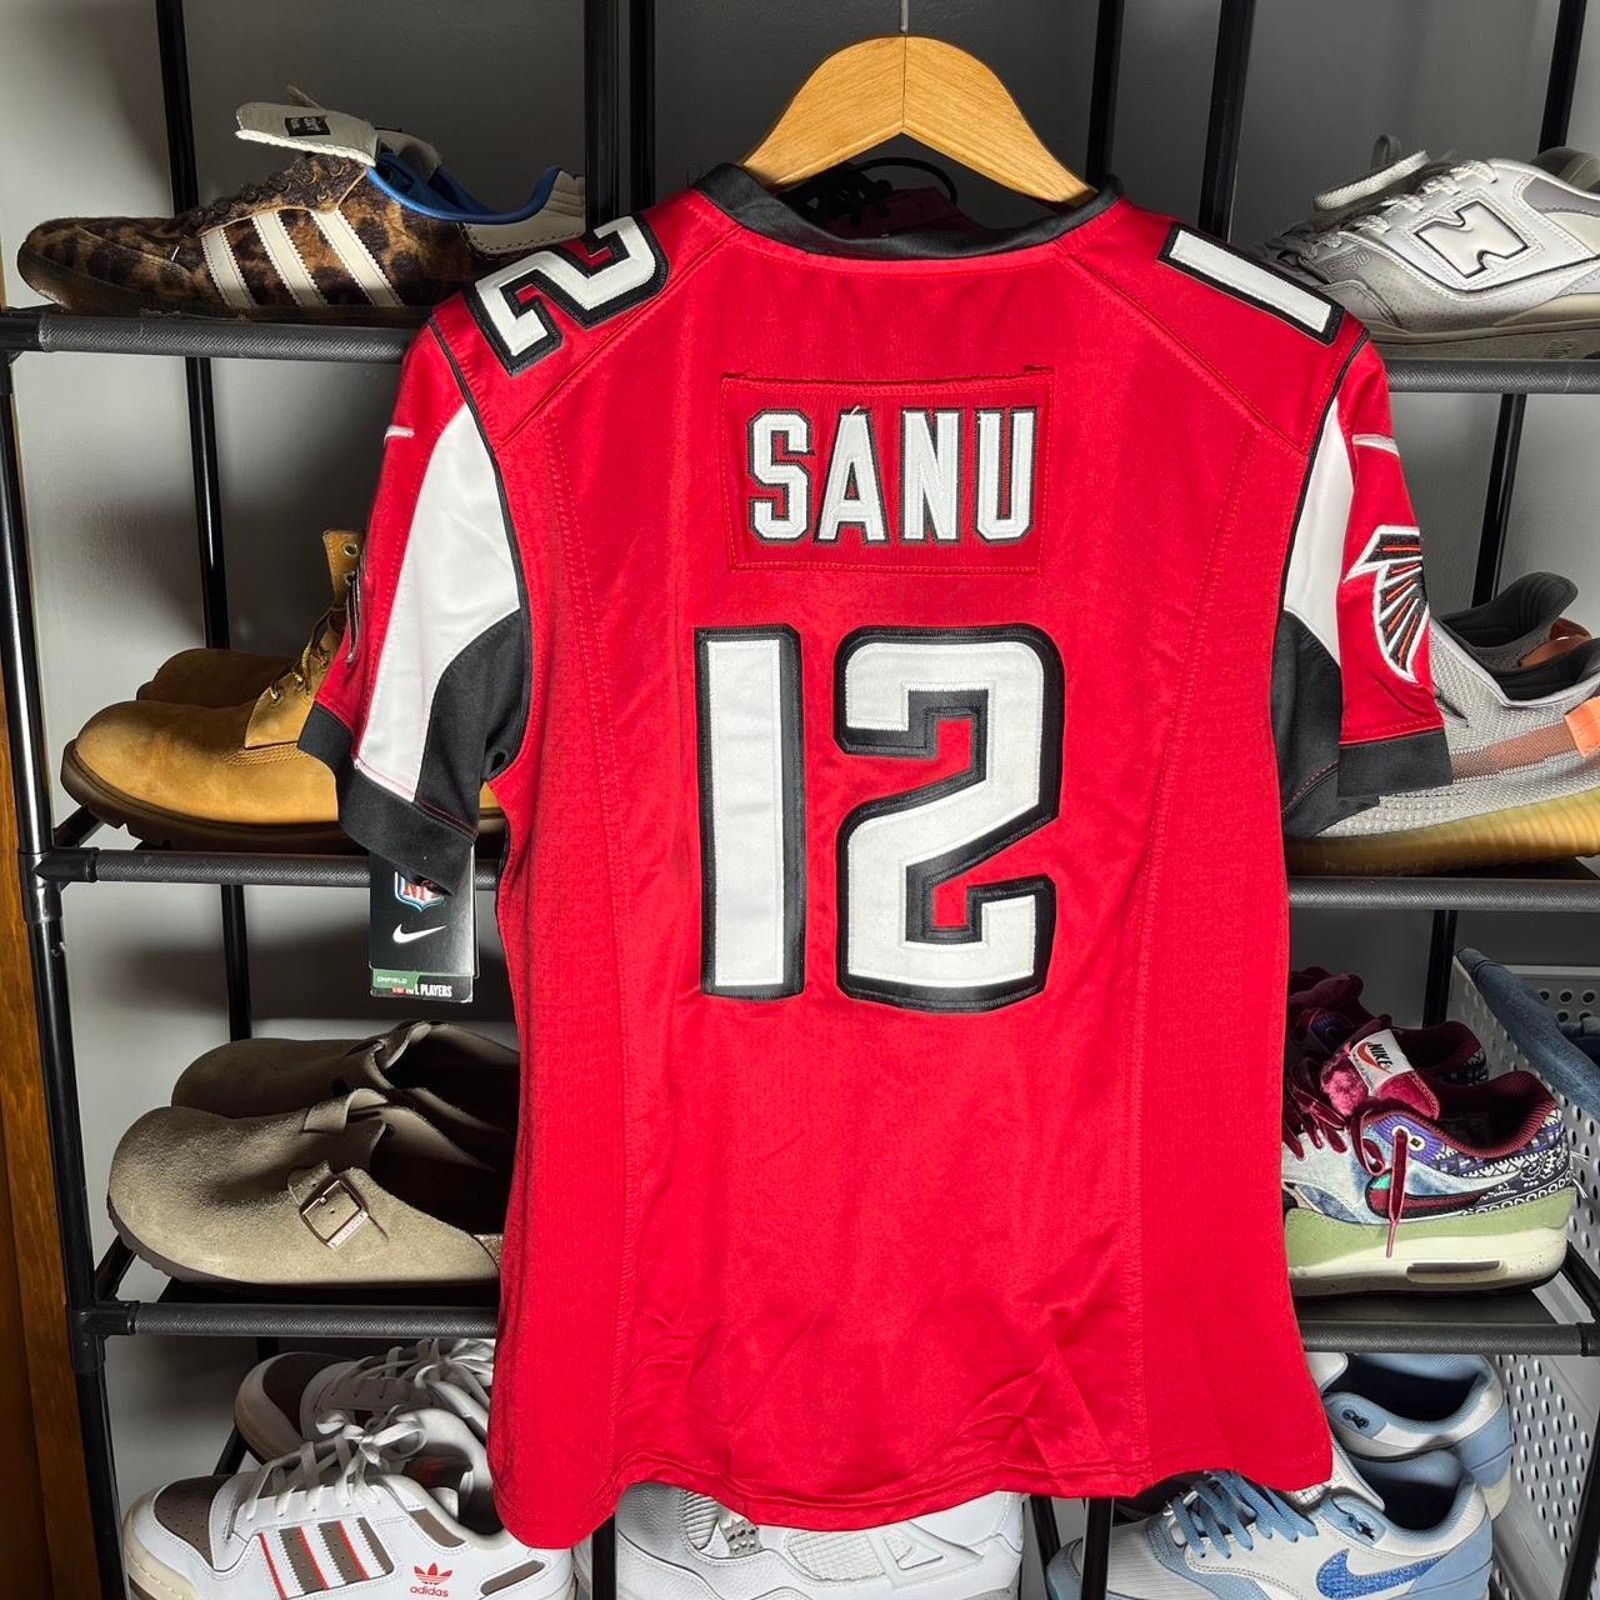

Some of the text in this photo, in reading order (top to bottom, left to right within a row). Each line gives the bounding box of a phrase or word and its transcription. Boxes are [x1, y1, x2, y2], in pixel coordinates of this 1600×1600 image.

[464, 213, 670, 377] 2
[748, 405, 1037, 546] SANU
[694, 623, 1065, 1017] 12
[420, 983, 453, 998] PLAYERS
[1367, 1043, 1394, 1069] NIKE
[409, 1585, 449, 1598] adidas
